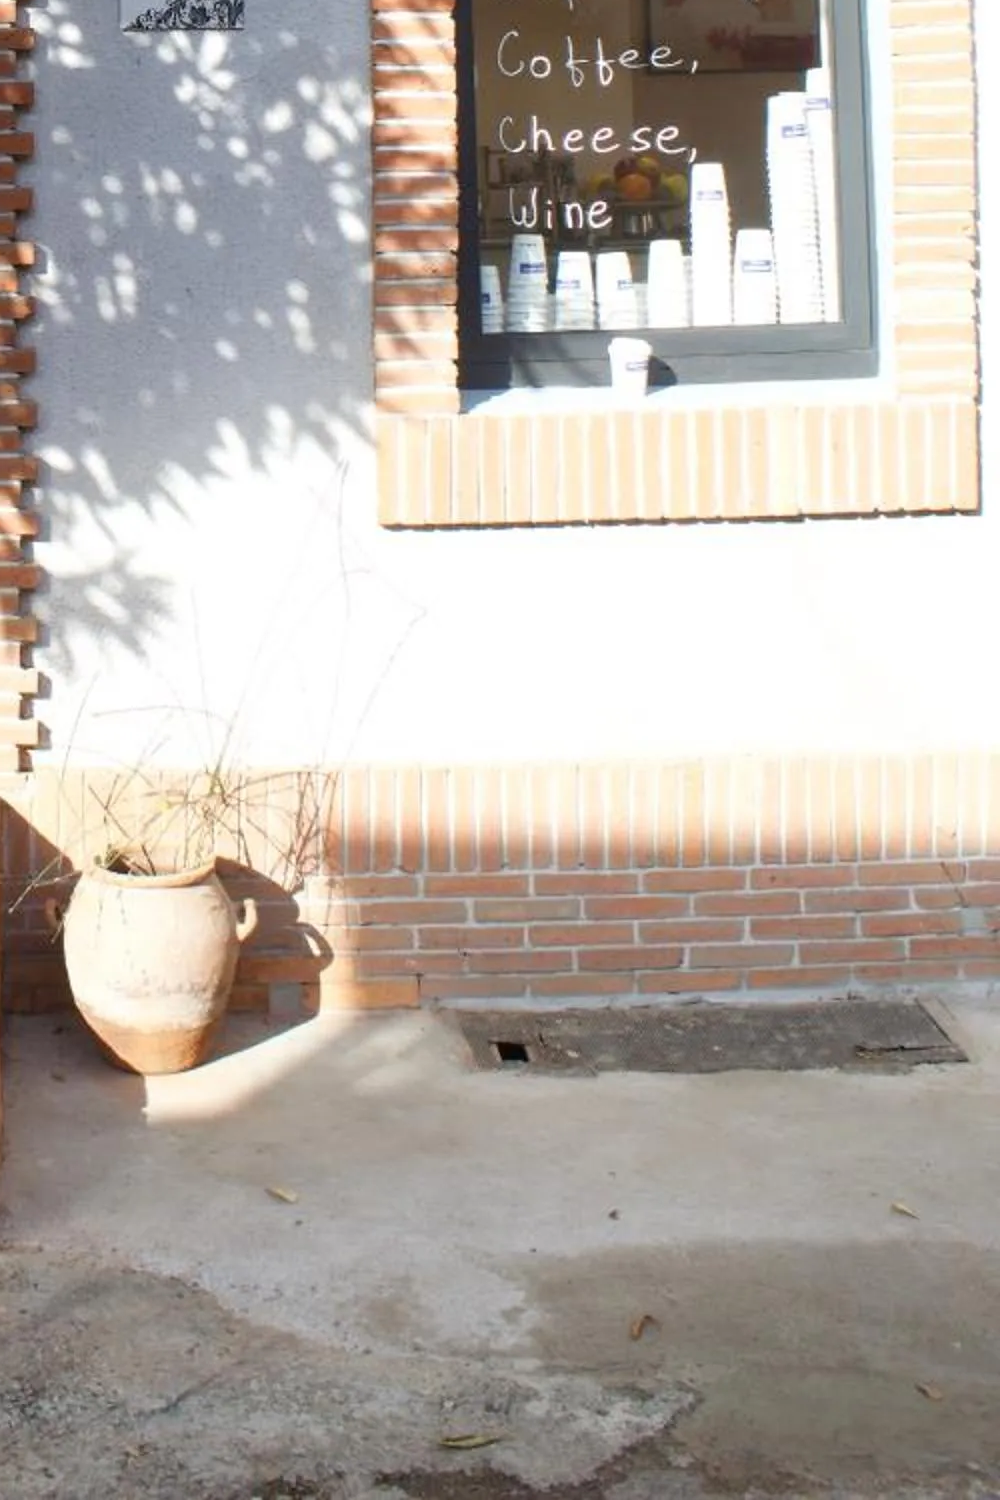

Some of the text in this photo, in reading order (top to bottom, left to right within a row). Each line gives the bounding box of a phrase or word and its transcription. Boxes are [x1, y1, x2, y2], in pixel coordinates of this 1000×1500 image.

[497, 30, 699, 87] Coffee,
[499, 115, 698, 164] Cheese,
[508, 186, 613, 229] Wine
